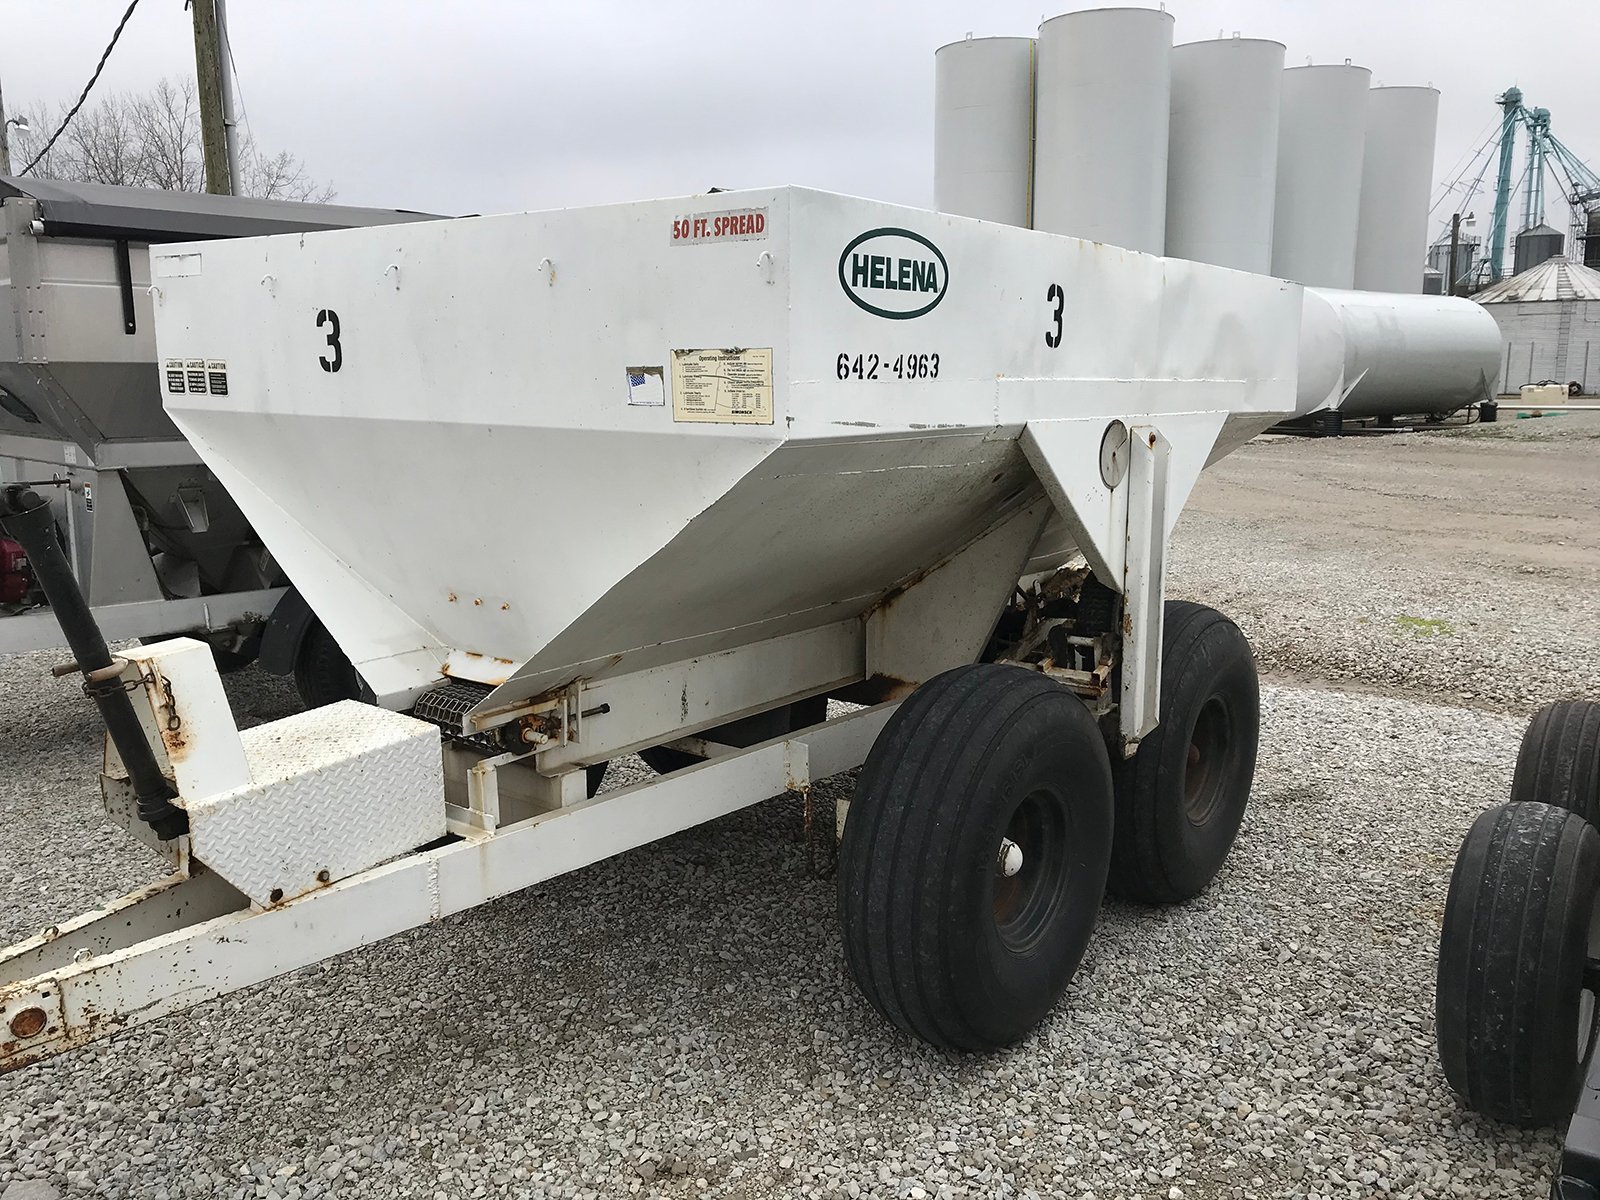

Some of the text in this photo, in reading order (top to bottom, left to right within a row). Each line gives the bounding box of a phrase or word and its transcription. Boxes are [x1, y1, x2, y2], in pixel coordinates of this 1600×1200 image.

[673, 213, 765, 240] 50 FT. SPREAD
[851, 253, 938, 293] HELENA
[1045, 283, 1065, 349] 3
[316, 309, 343, 373] 3
[837, 353, 940, 380] 642-4963
